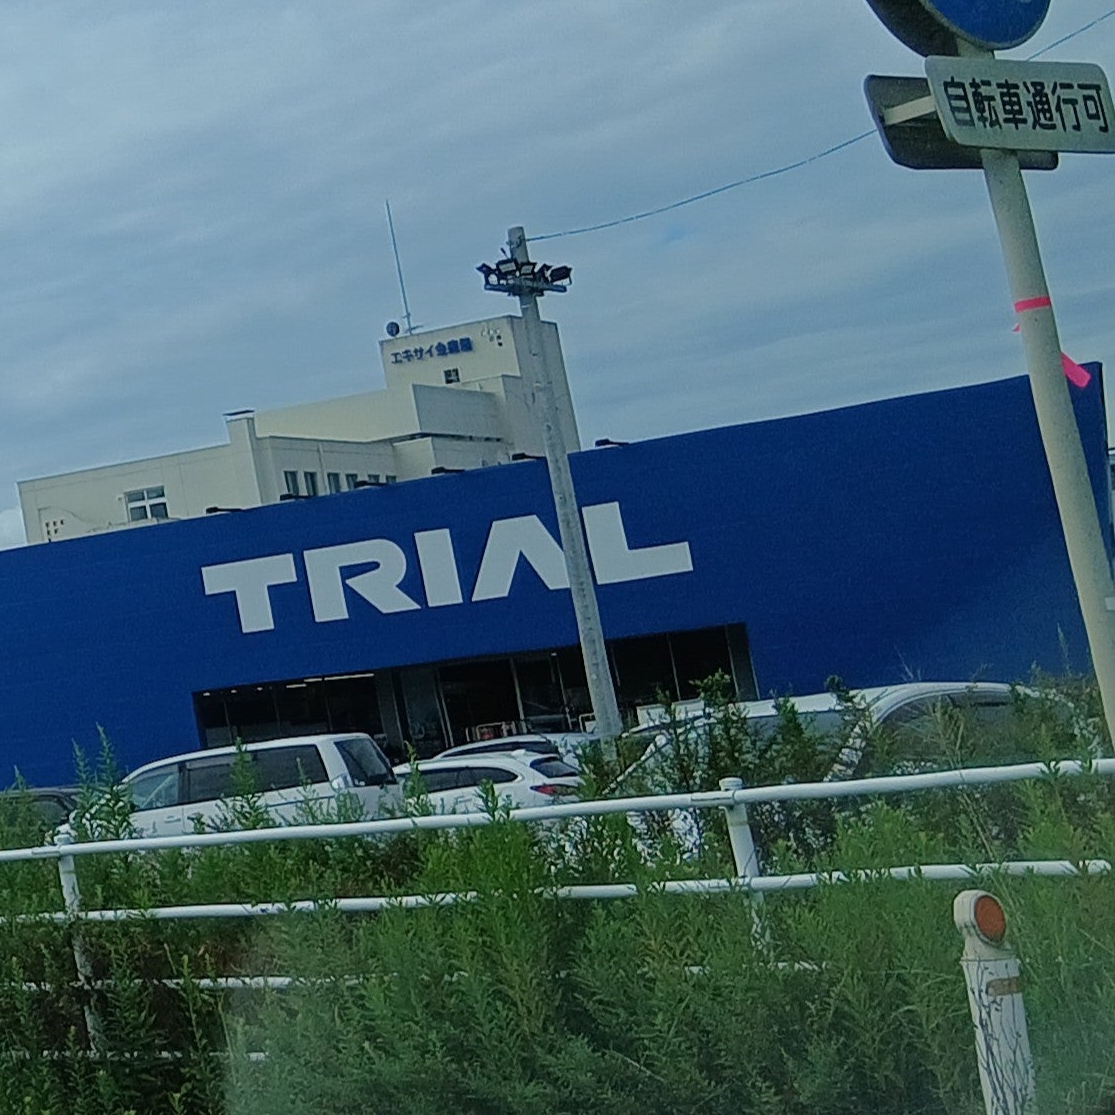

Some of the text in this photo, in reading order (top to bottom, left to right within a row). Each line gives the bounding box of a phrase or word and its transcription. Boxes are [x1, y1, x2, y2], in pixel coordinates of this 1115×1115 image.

[942, 75, 1109, 133] 自転車通行可
[201, 501, 694, 634] TRIAL
